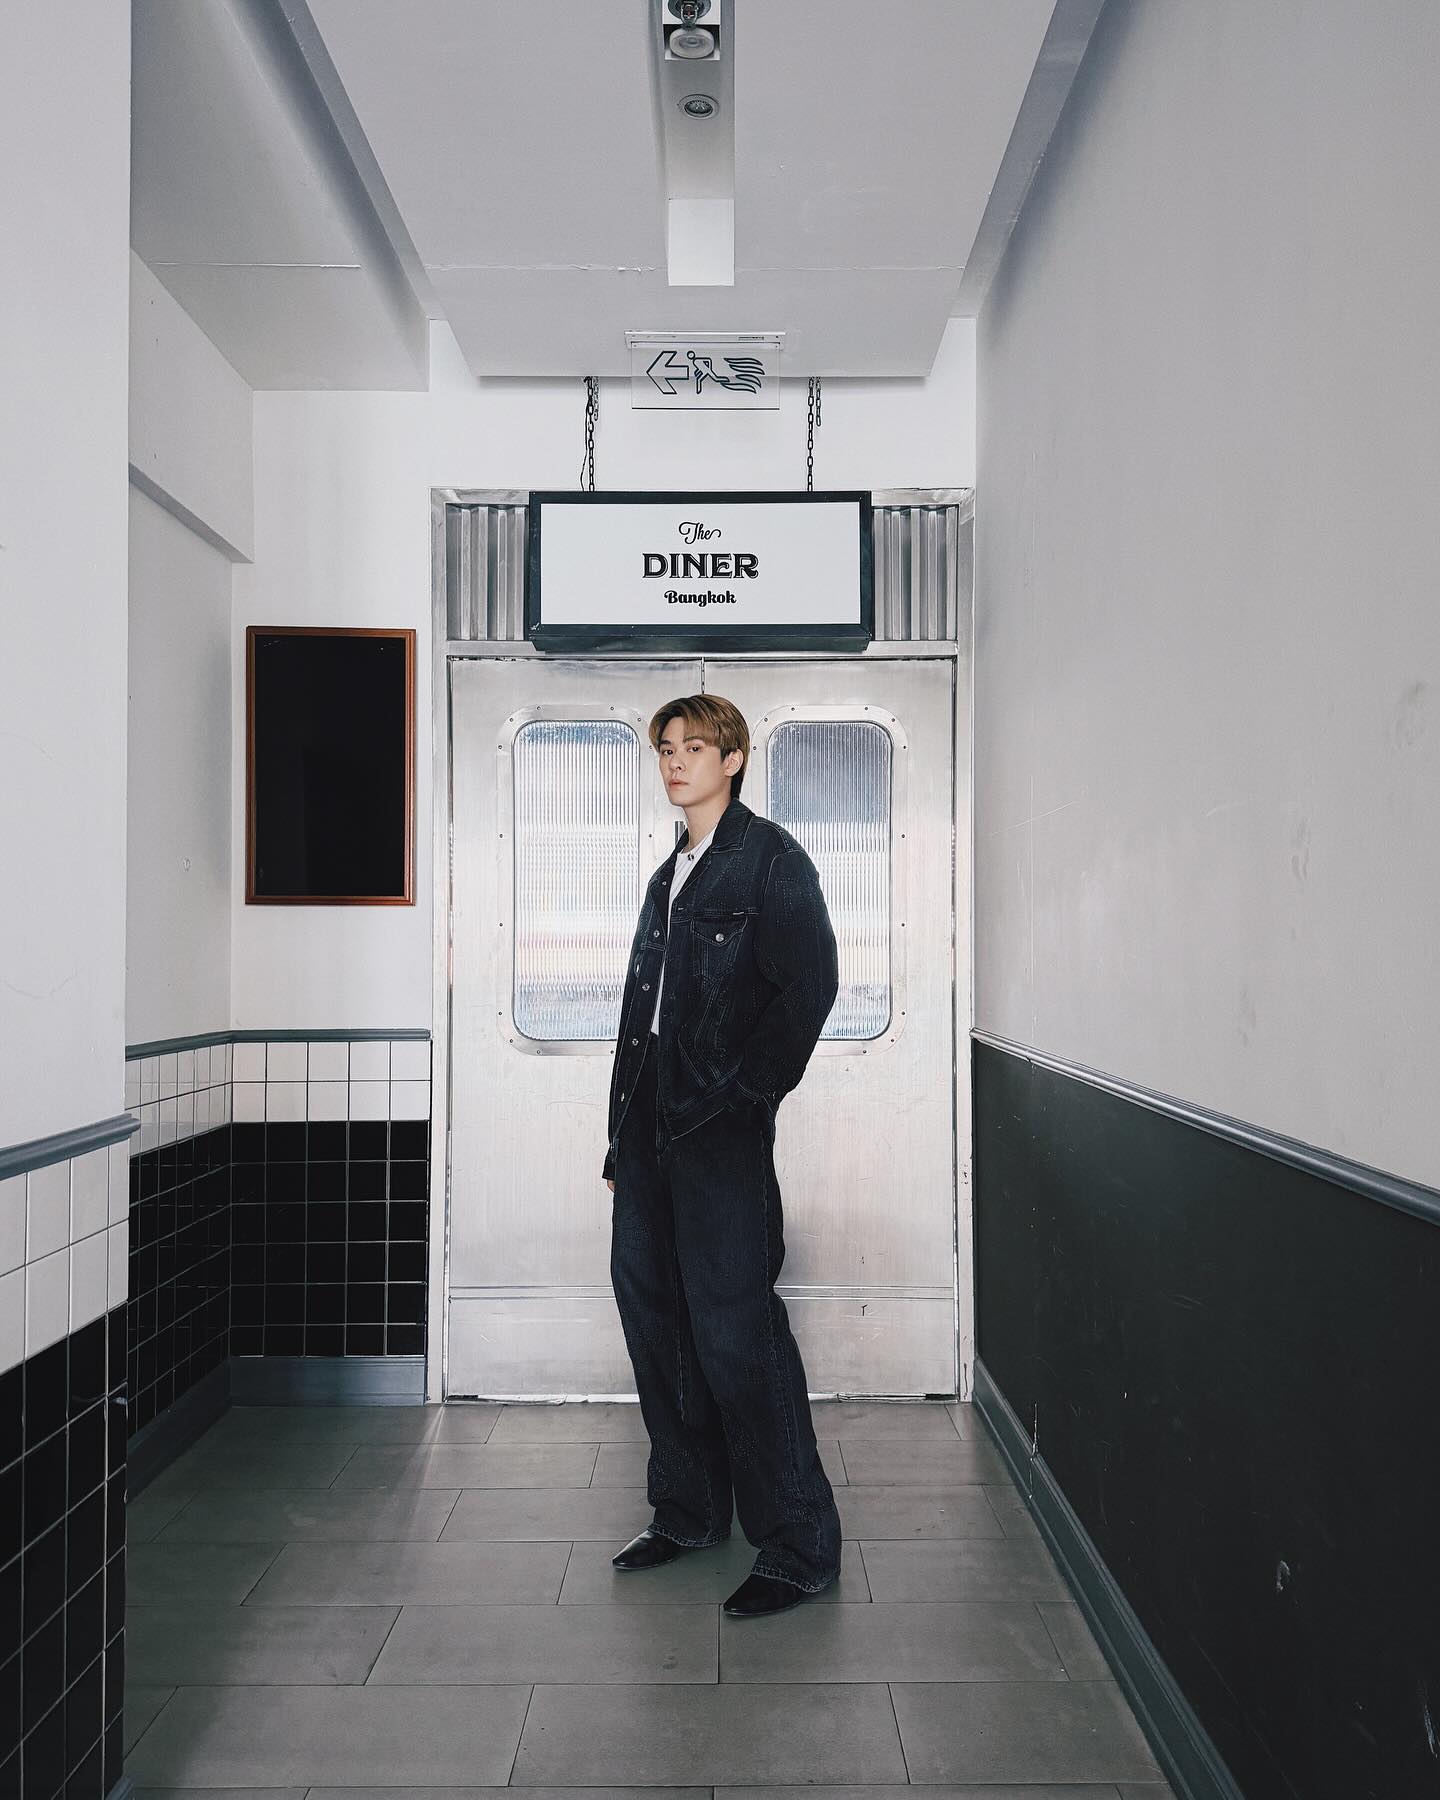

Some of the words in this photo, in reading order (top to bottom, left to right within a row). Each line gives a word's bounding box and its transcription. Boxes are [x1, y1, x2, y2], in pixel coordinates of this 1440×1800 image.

[678, 521, 721, 545] The
[642, 553, 759, 580] DINER
[664, 590, 737, 608] Bangkok
